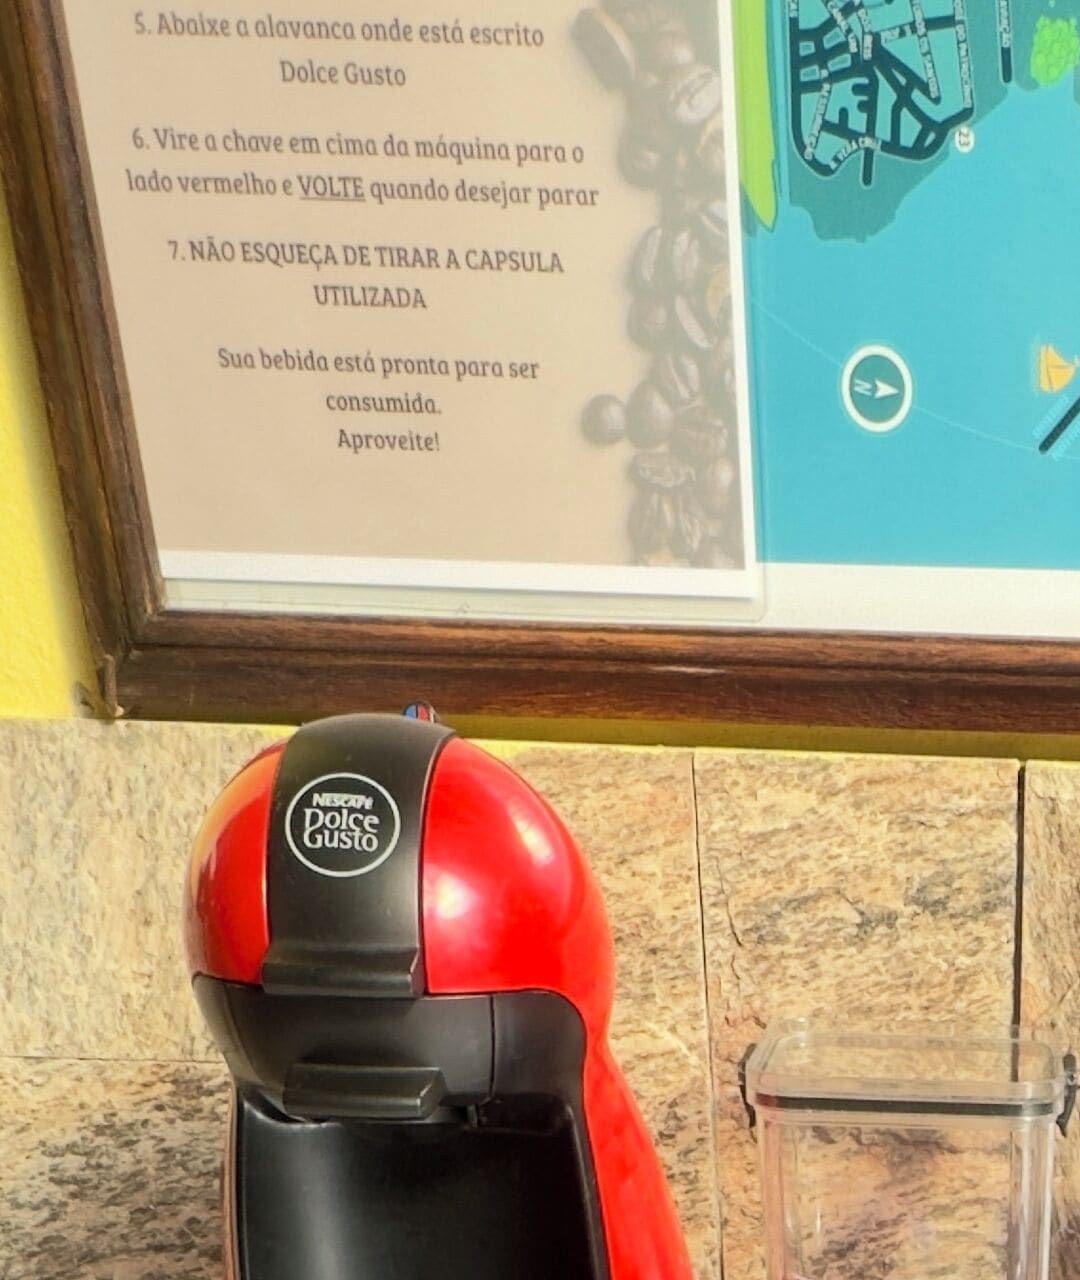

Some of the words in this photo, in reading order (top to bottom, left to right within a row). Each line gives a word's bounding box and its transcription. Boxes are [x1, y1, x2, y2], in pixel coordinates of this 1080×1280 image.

[135, 12, 151, 34] 5.
[157, 11, 230, 37] Abaixe
[236, 19, 249, 37] a
[255, 14, 356, 40] alavanca
[361, 18, 413, 42] onde
[419, 19, 464, 44] está
[470, 23, 544, 47] escrito
[279, 59, 338, 84] Dolce
[344, 62, 406, 86] Gusto
[132, 128, 149, 149] 6.
[153, 127, 199, 151] Vire
[205, 134, 218, 151] a
[222, 128, 283, 153] chave
[289, 137, 321, 154] em
[326, 133, 378, 156] cima
[383, 133, 410, 157] da
[414, 134, 510, 165] máquina
[515, 144, 567, 167] para
[572, 146, 584, 163] o
[125, 168, 173, 192] lado
[177, 172, 277, 196] vermelho
[282, 179, 293, 196] e
[296, 175, 366, 202] VOLTE
[370, 178, 449, 205] quando
[455, 179, 532, 209] desejar
[537, 188, 599, 210] parar
[167, 240, 185, 261] 7.
[188, 236, 235, 262] NÃO
[240, 241, 338, 271] ESQUEÇA
[342, 245, 371, 266] DE
[376, 246, 441, 268] TIRAR
[446, 249, 461, 270] A
[465, 249, 564, 273] CAPSULA
[313, 285, 427, 309] UTILIZADA
[218, 348, 256, 369] Sua
[259, 348, 329, 371] bebida
[334, 350, 375, 373] está
[381, 358, 450, 379] pronta
[454, 360, 504, 382] para
[509, 362, 540, 379] ser
[854, 379, 873, 395] N
[326, 392, 442, 414] consumida.
[338, 429, 440, 454] Aproveite!
[303, 808, 381, 834] Dolce
[303, 824, 380, 853] Gusto
